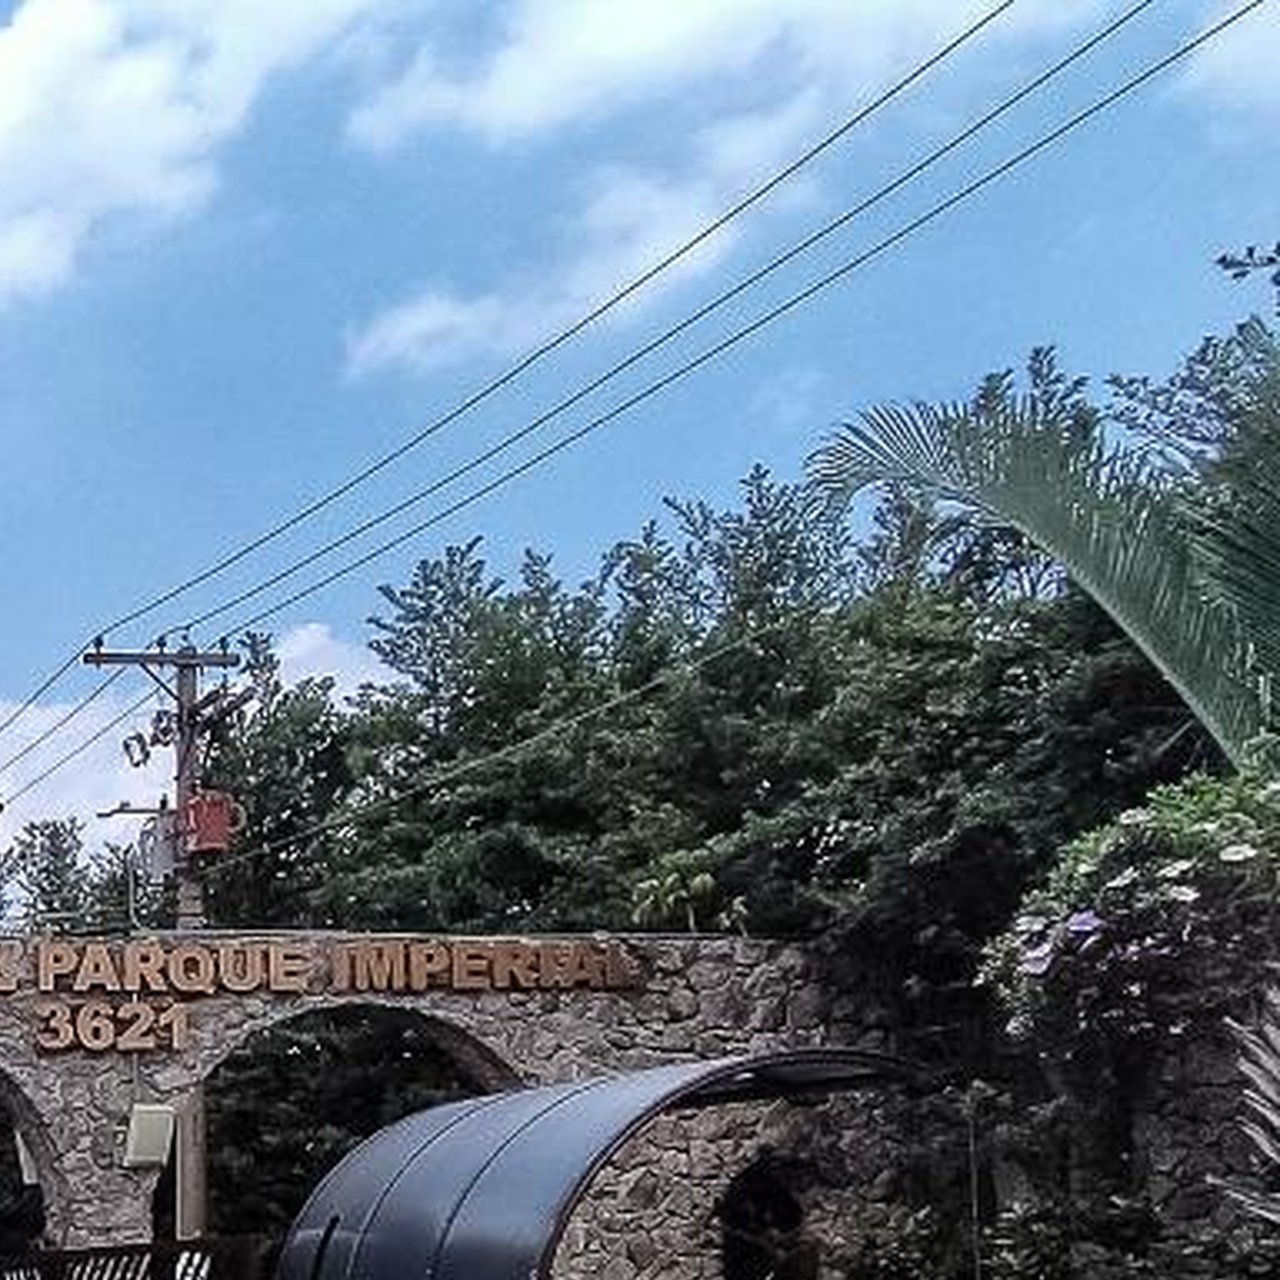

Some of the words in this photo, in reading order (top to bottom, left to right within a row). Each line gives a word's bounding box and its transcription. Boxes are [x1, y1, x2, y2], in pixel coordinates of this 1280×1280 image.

[40, 941, 307, 993] PARQUE
[331, 940, 639, 993] IMPERIAL
[40, 1003, 190, 1051] 3621
